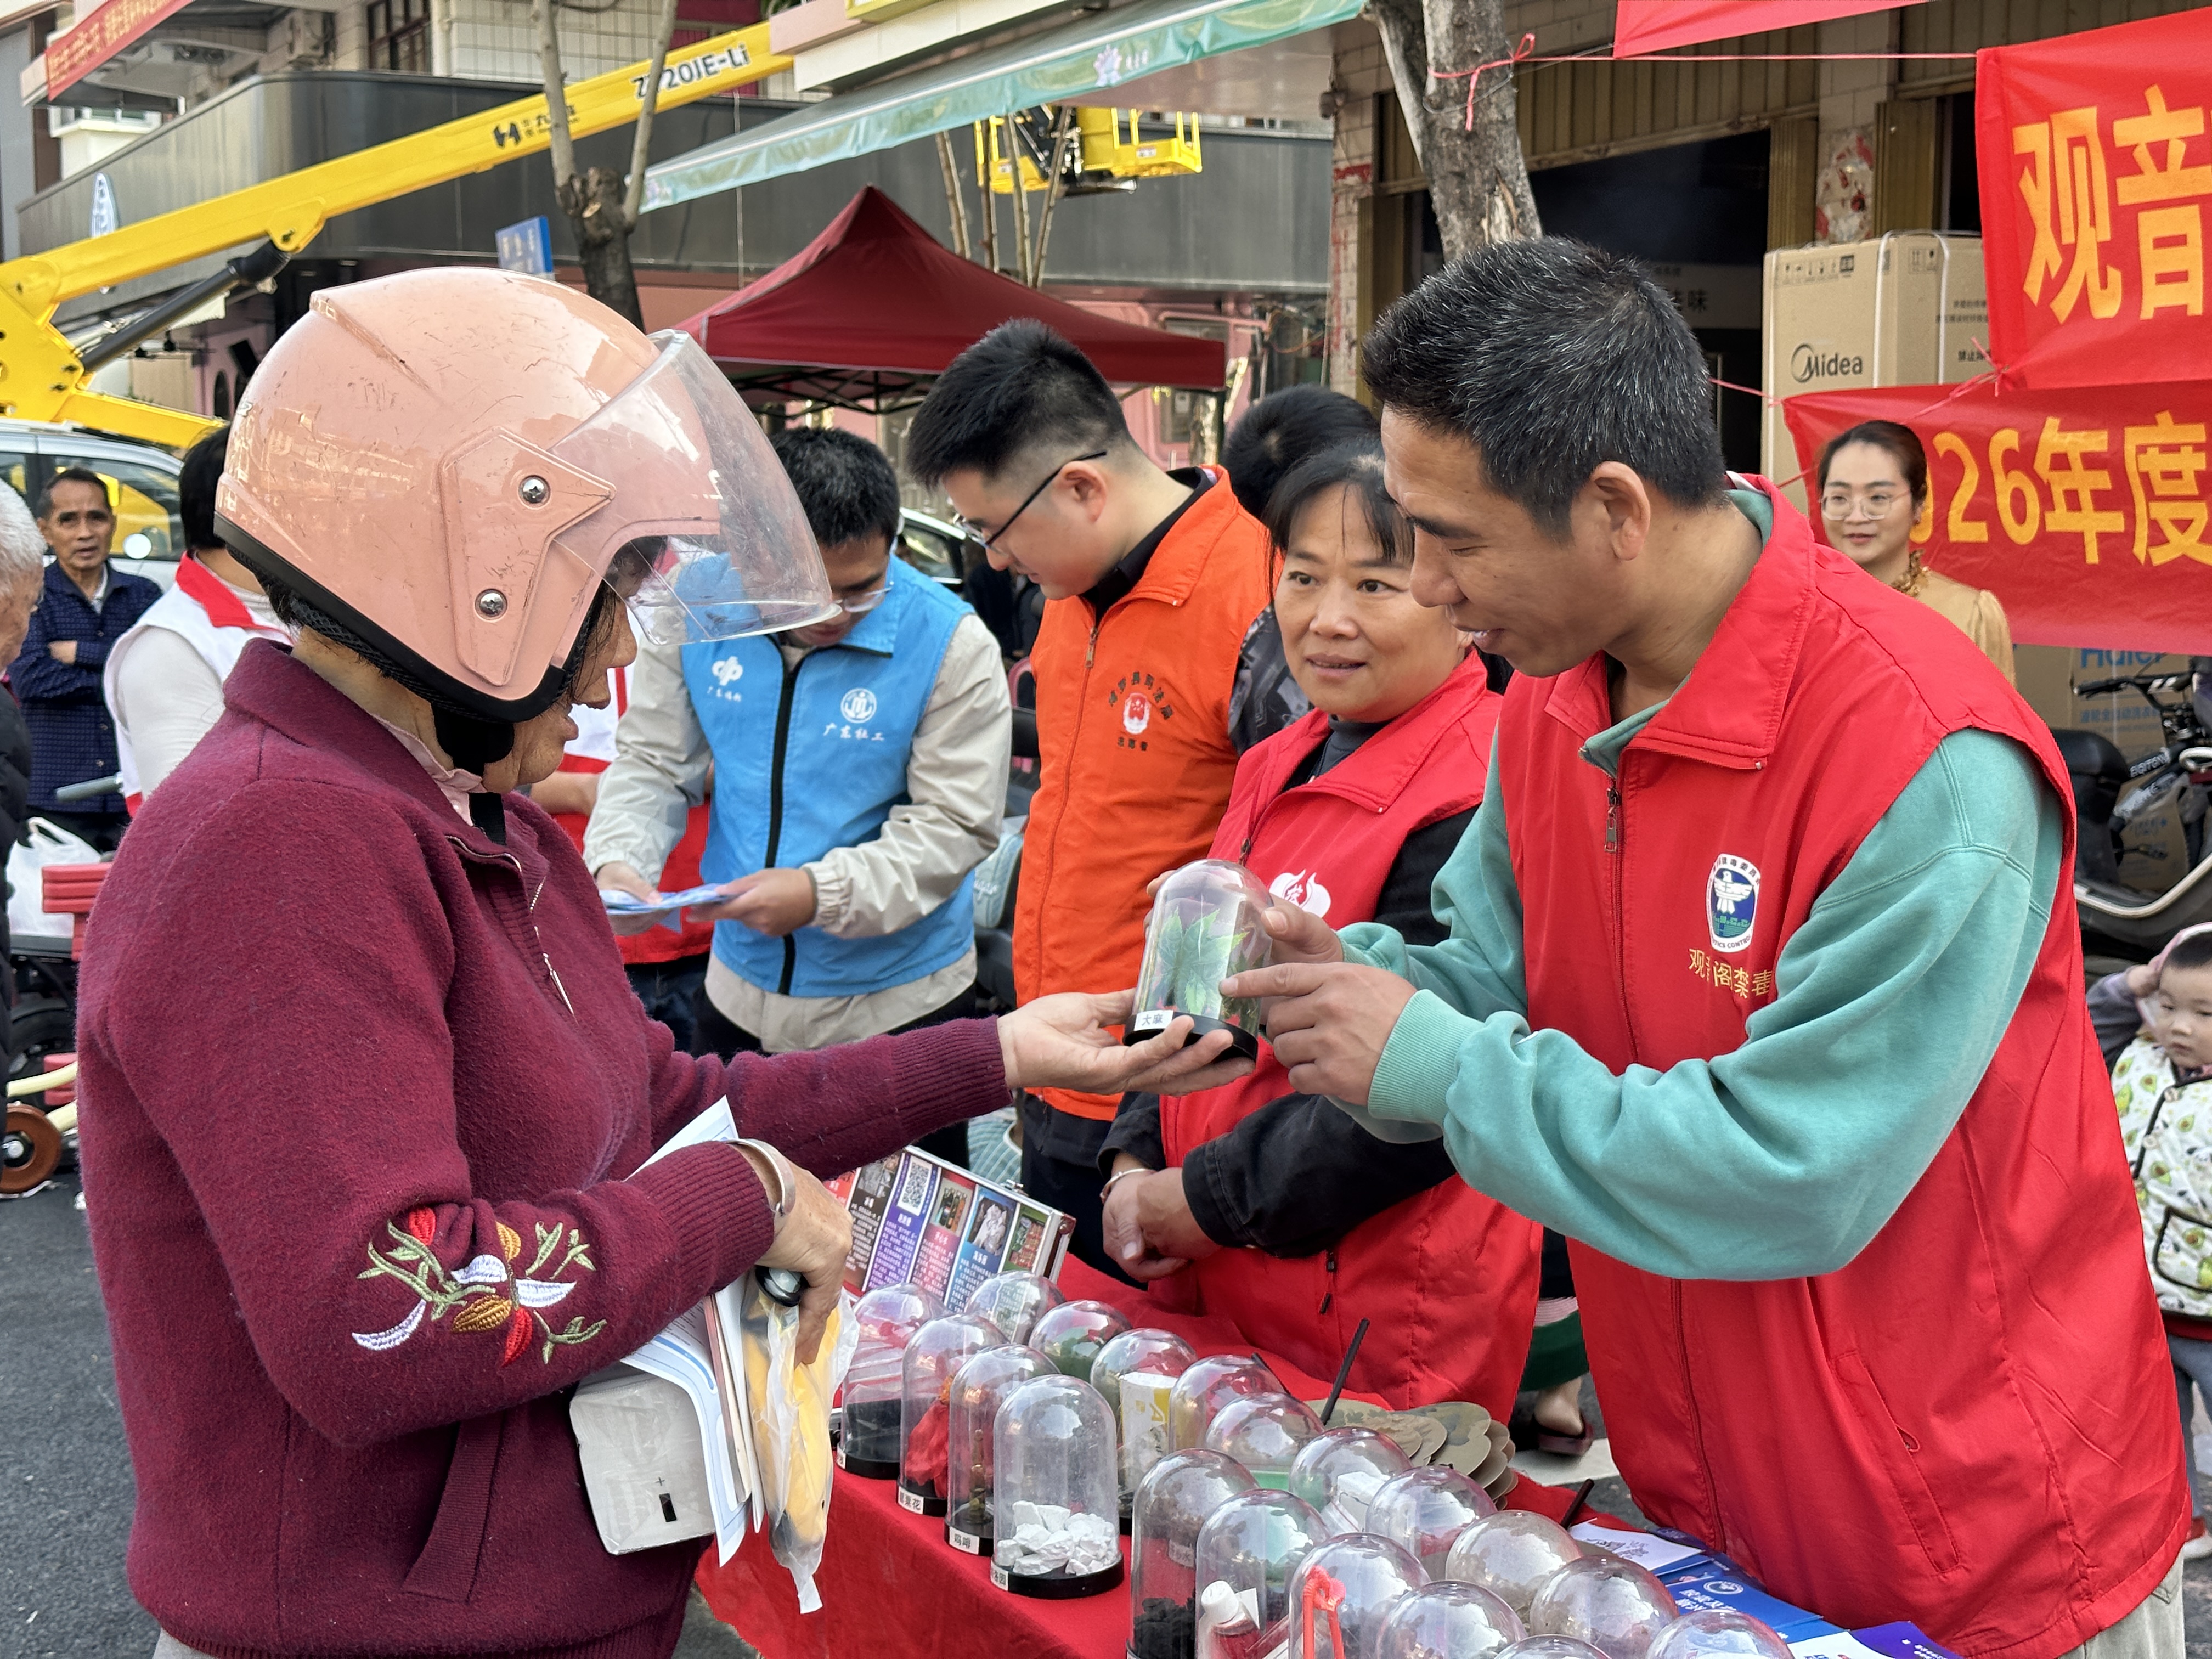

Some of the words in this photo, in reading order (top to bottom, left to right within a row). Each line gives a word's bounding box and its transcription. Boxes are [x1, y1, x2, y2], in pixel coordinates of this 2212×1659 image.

[2012, 85, 2212, 325] 观音
[1795, 346, 1864, 382] Midea
[1142, 1013, 1164, 1026] 大麻
